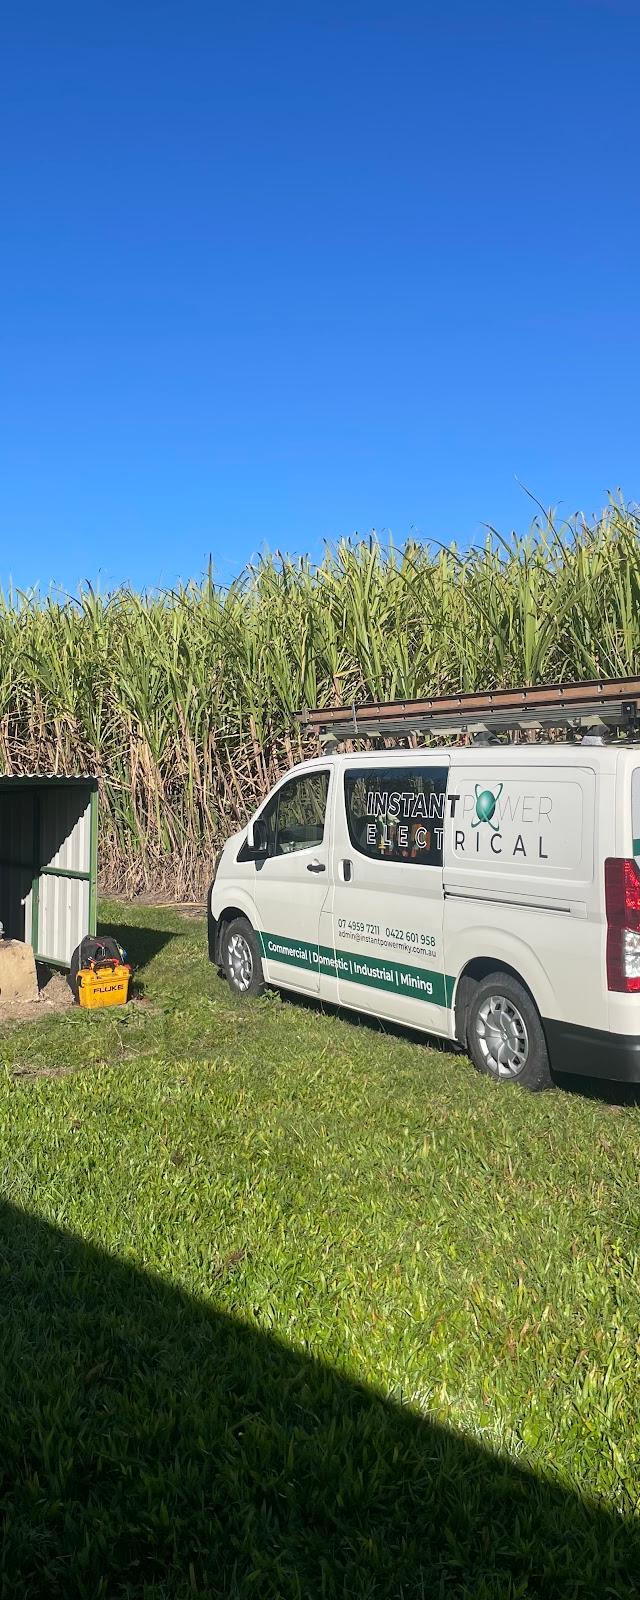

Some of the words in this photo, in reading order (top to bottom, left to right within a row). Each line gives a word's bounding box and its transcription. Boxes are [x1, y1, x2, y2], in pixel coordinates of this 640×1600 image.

[366, 823, 549, 859] ELECTRICAL
[338, 918, 347, 928] 07
[347, 920, 365, 932] 4959
[366, 923, 380, 935] 7211
[385, 927, 404, 940] 0422
[405, 931, 419, 944] 601
[420, 934, 436, 947] 958
[267, 940, 308, 961] Commercial
[313, 951, 349, 971] Domestic
[354, 961, 394, 982] Industrial
[400, 973, 433, 994] Mining
[93, 984, 124, 994] FLUKE
